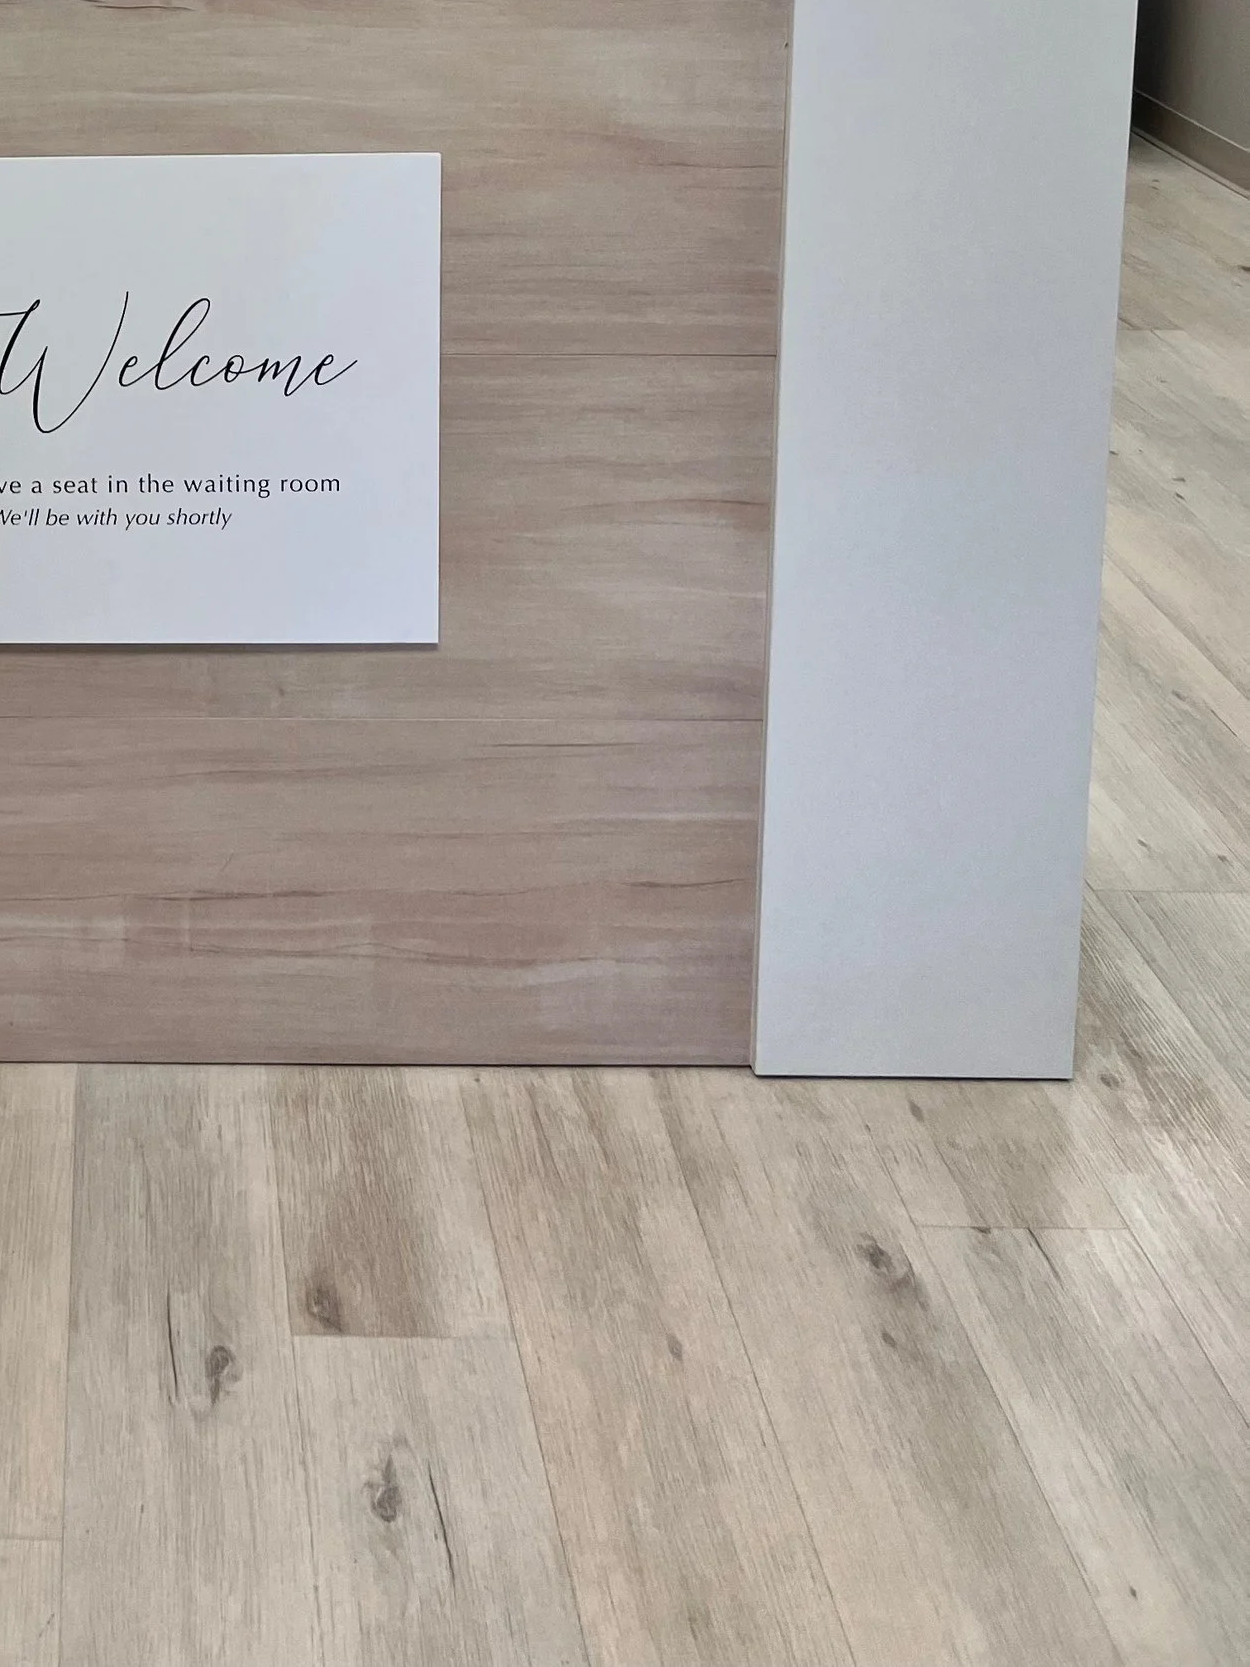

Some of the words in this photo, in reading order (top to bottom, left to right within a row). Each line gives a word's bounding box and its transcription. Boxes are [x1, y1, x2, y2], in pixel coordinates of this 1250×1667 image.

[31, 480, 43, 494] a
[52, 477, 98, 494] seat
[108, 474, 128, 494] in
[138, 473, 174, 494] the
[183, 474, 271, 499] waiting
[280, 478, 340, 494] room
[45, 508, 70, 526] be
[76, 507, 118, 526] with
[125, 513, 161, 531] you
[166, 507, 233, 531] shortly
